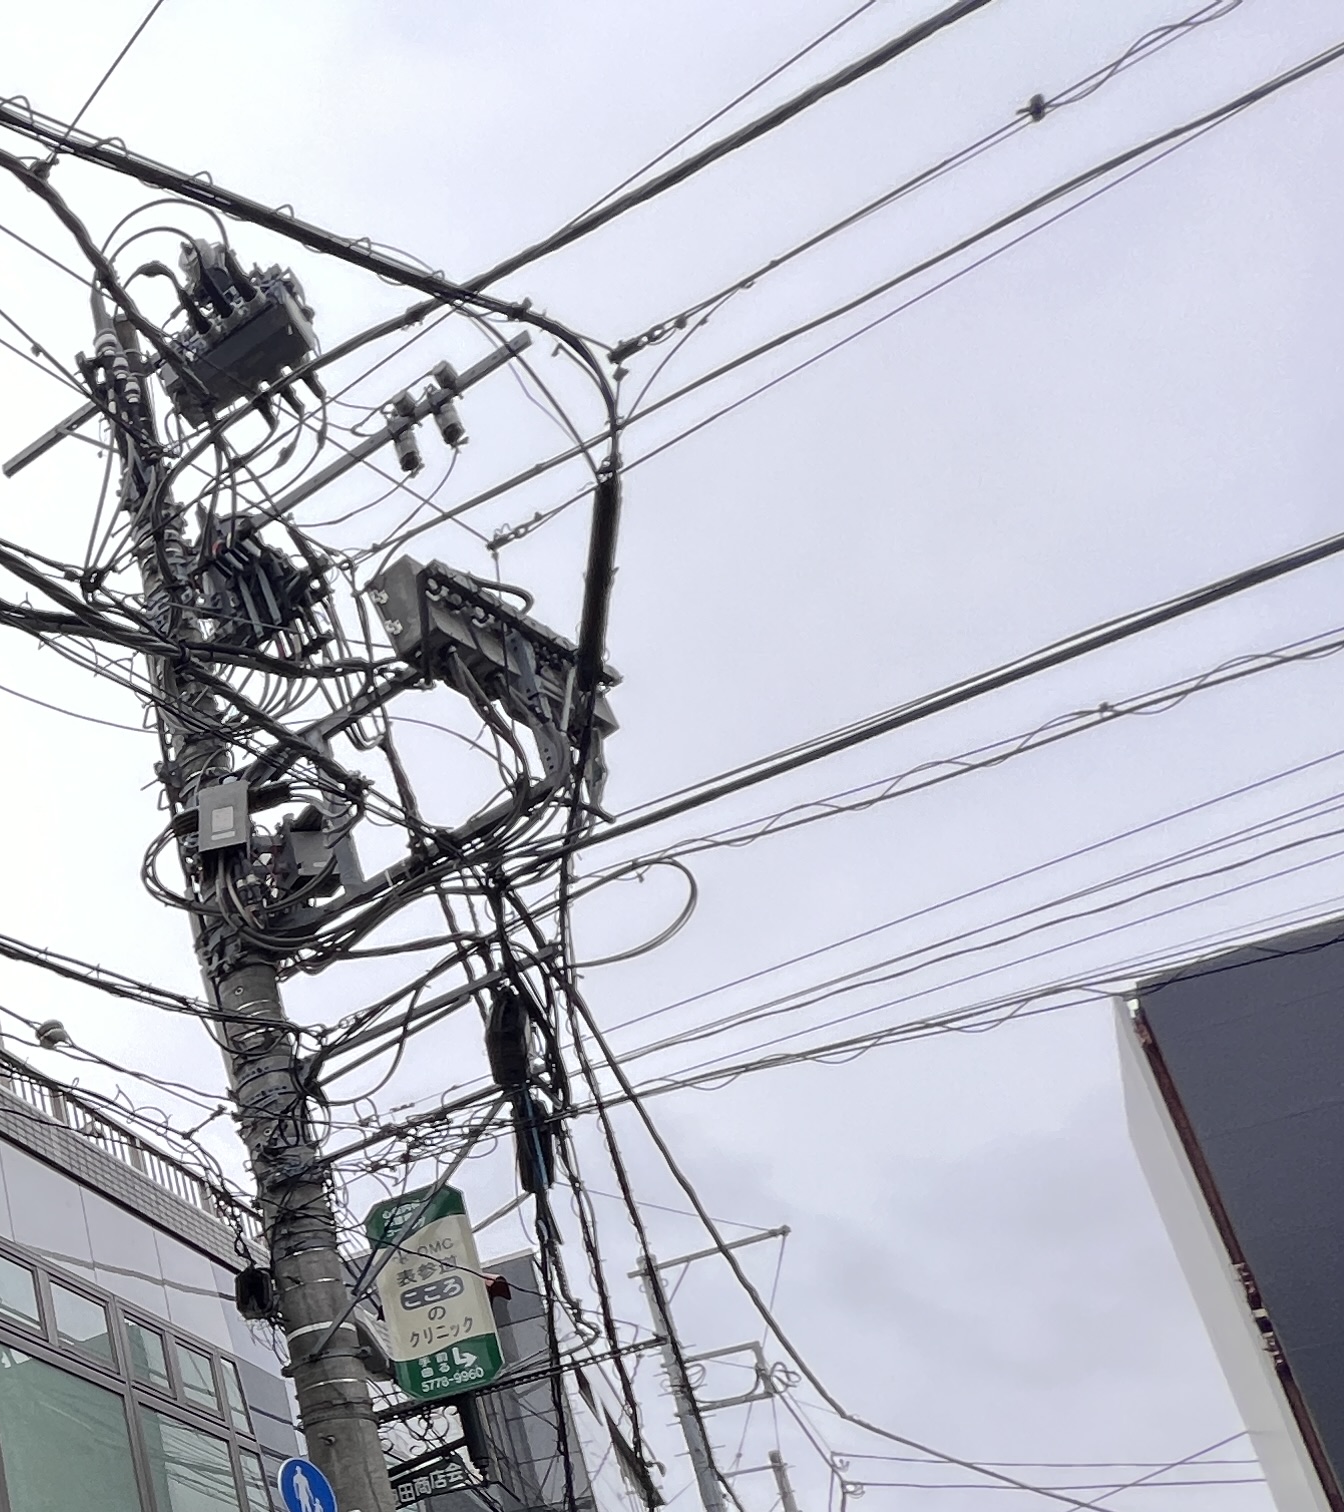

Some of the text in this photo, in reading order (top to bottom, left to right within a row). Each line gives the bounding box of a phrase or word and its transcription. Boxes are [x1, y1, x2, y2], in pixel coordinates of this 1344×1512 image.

[404, 1278, 461, 1307] こころ
[427, 1305, 446, 1321] の
[409, 1316, 473, 1348] クリニック
[421, 1366, 484, 1392] 5778-9960
[393, 1462, 464, 1503] 田商店会
